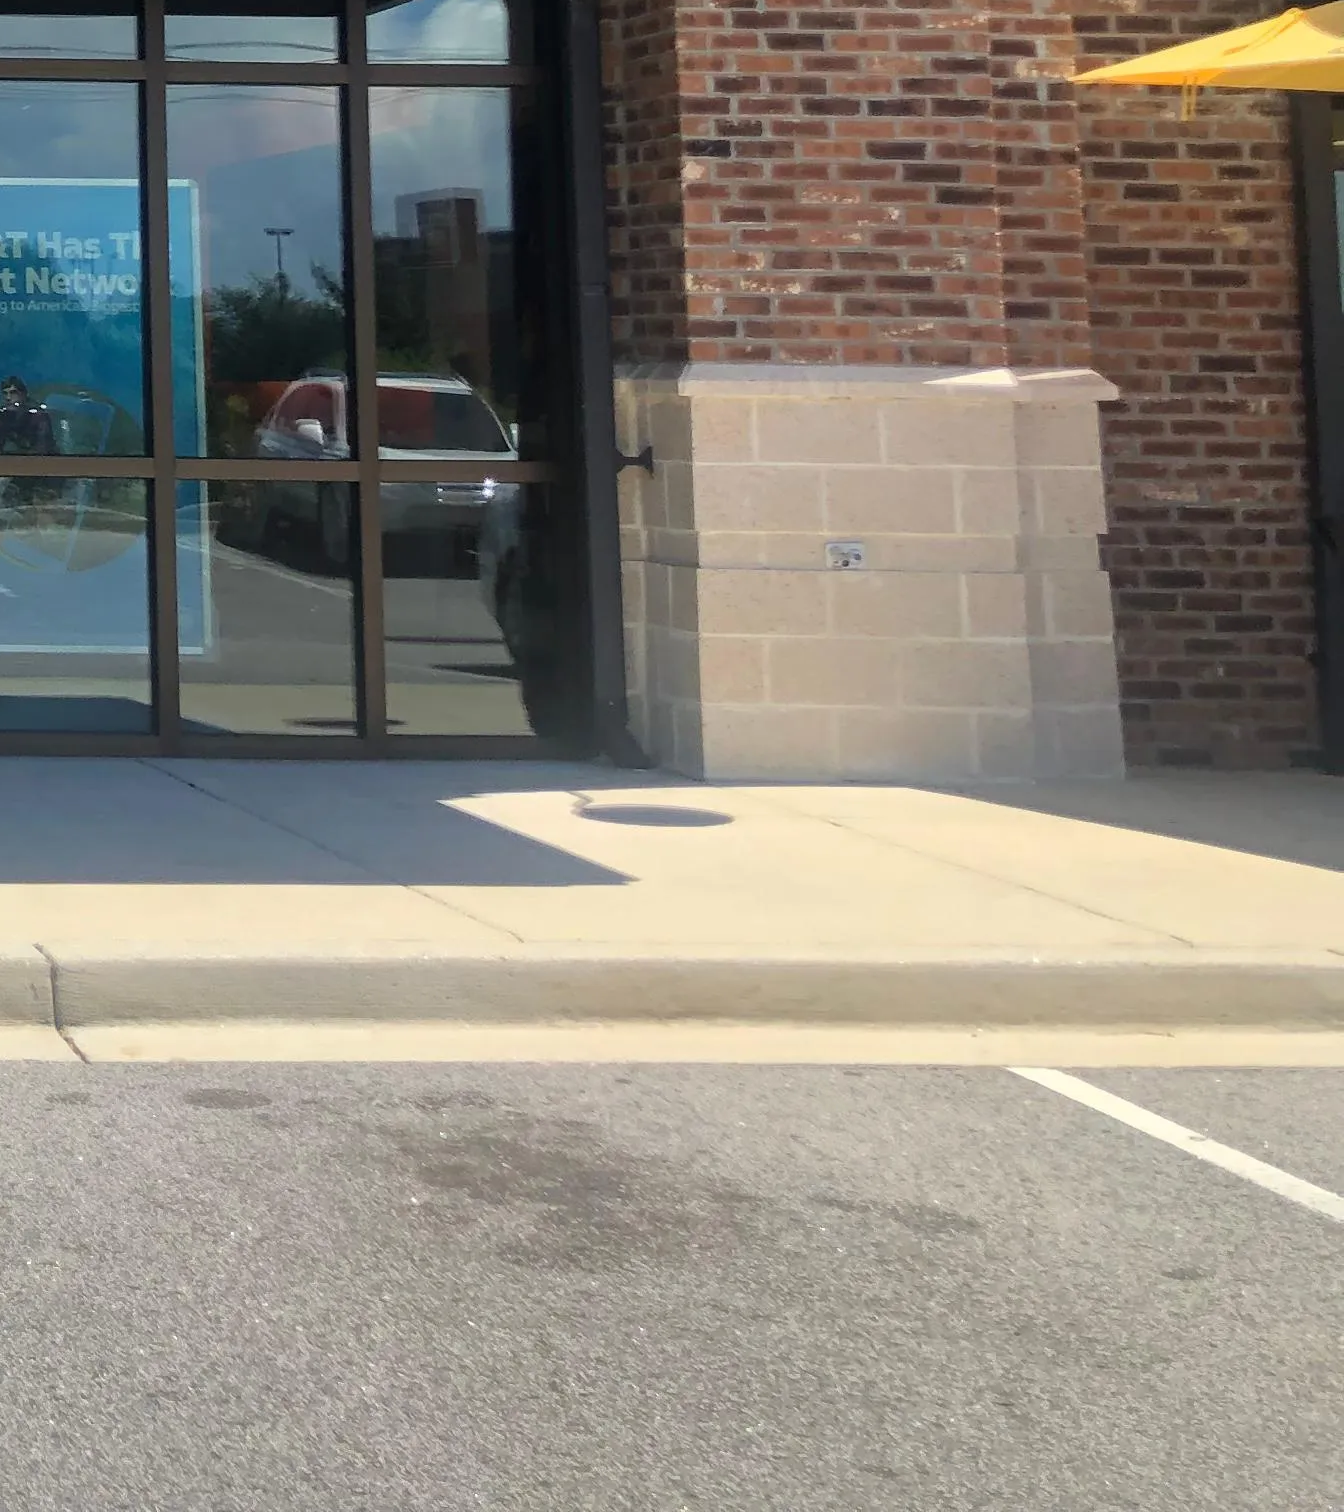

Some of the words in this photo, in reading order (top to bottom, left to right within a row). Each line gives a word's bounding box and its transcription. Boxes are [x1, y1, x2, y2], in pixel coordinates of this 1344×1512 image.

[37, 231, 101, 260] Has
[25, 266, 137, 296] Netwo
[10, 299, 24, 311] to
